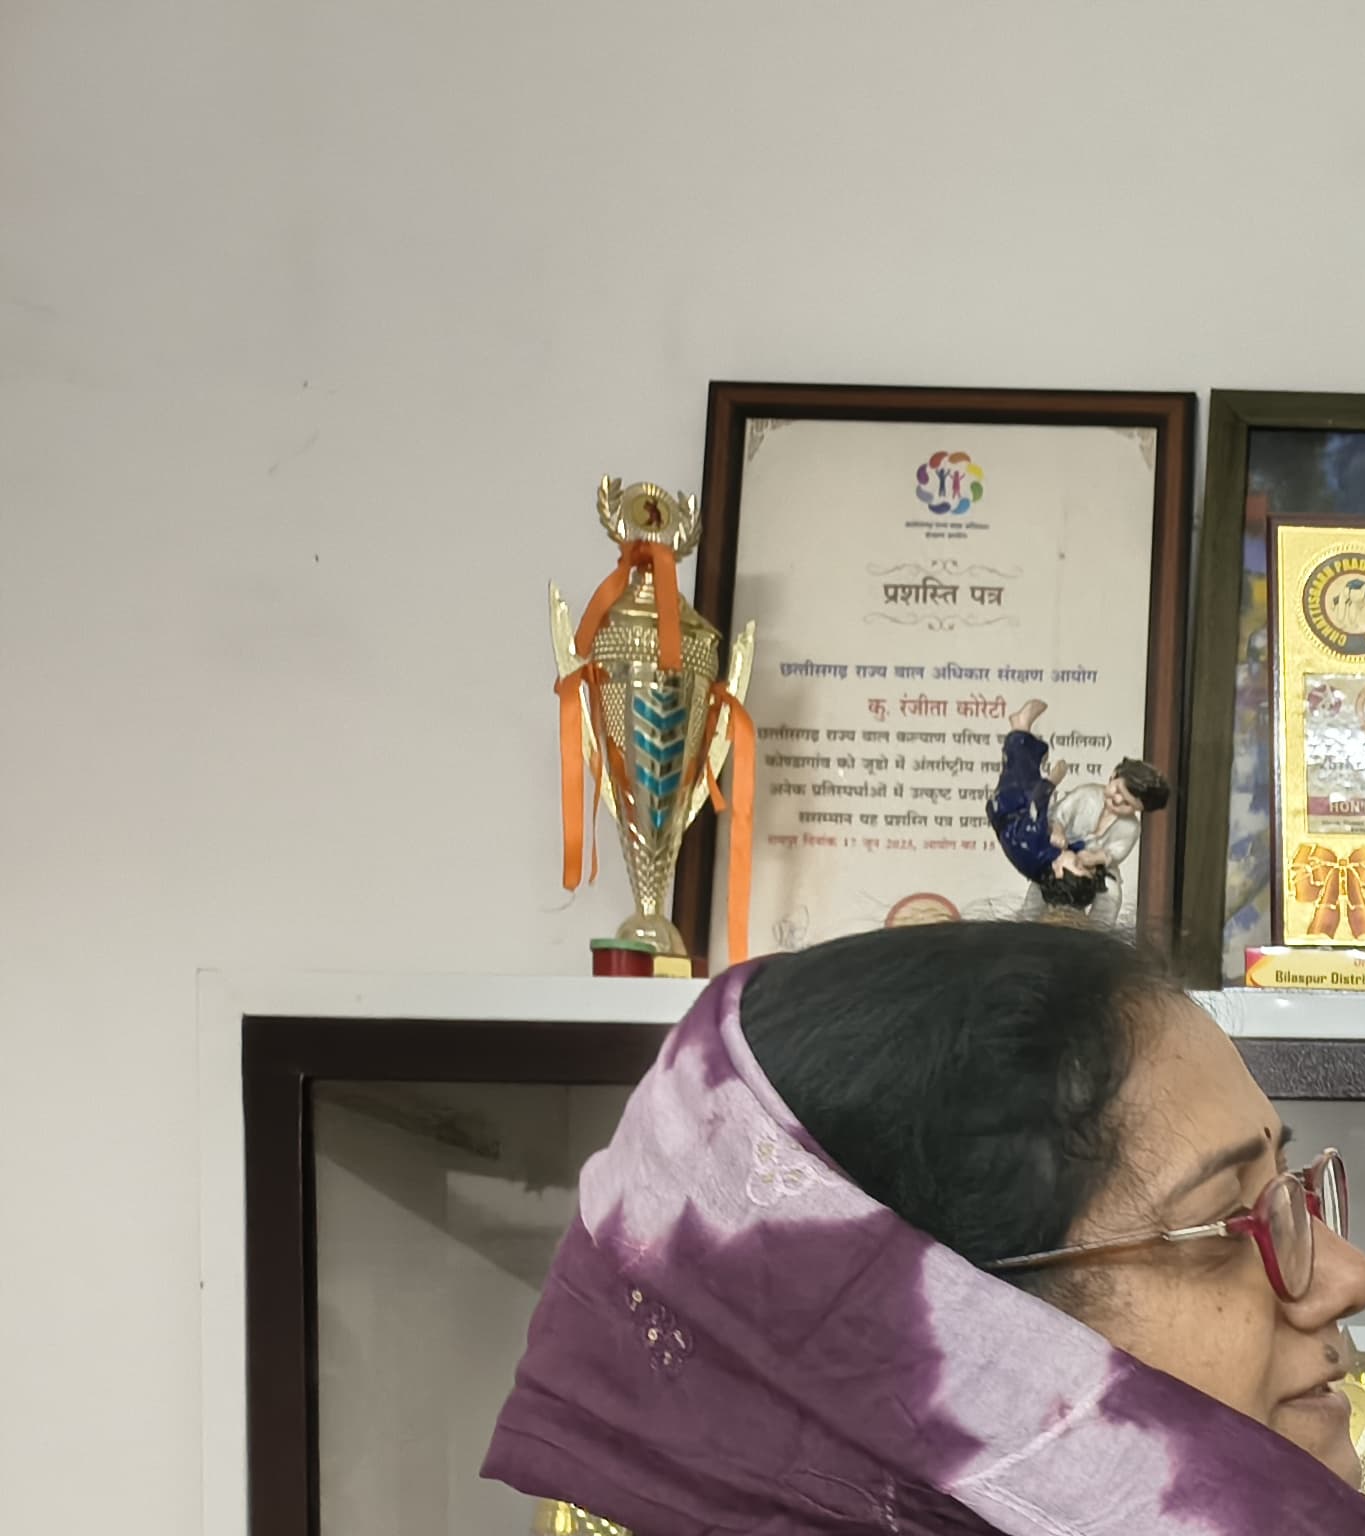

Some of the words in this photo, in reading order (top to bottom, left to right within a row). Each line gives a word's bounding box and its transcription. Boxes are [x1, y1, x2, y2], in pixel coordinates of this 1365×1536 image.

[883, 576, 959, 605] प्रशस्ति
[970, 586, 1004, 605] पत्र
[933, 662, 990, 680] अधिकार
[900, 693, 948, 716] रंजीता
[956, 692, 1006, 719] कोरेटी
[1275, 970, 1327, 986] Bilaspur
